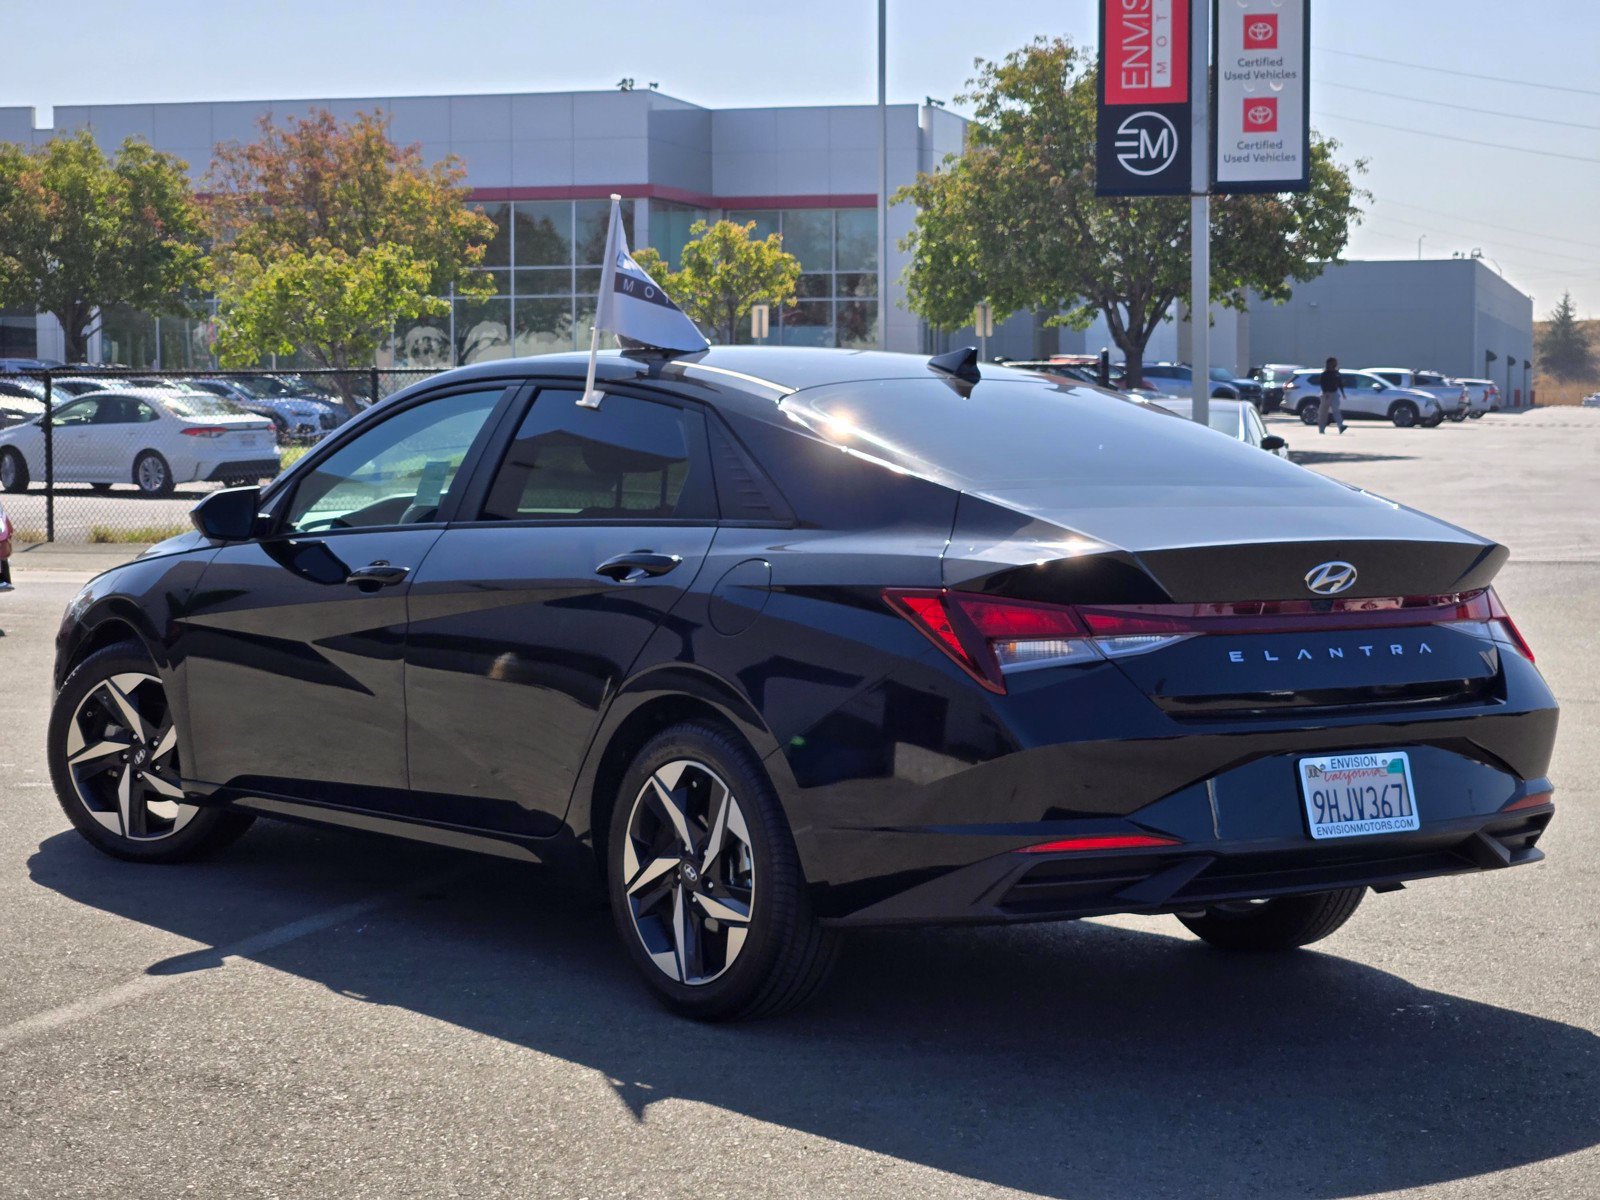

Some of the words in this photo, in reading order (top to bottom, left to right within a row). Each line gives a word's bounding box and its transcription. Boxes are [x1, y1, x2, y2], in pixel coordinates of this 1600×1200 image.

[1238, 56, 1283, 68] Certified
[1224, 70, 1251, 81] Used
[1253, 69, 1297, 80] Vehicles
[1236, 140, 1283, 151] Certified
[1223, 154, 1250, 163] Used
[1253, 152, 1296, 162] Vehicles
[1229, 643, 1432, 662] ELANTRA
[1331, 756, 1377, 769] ENVISION
[1313, 784, 1403, 824] 9HJV367
[1316, 819, 1414, 836] ENVISIONMOTORS.COM
